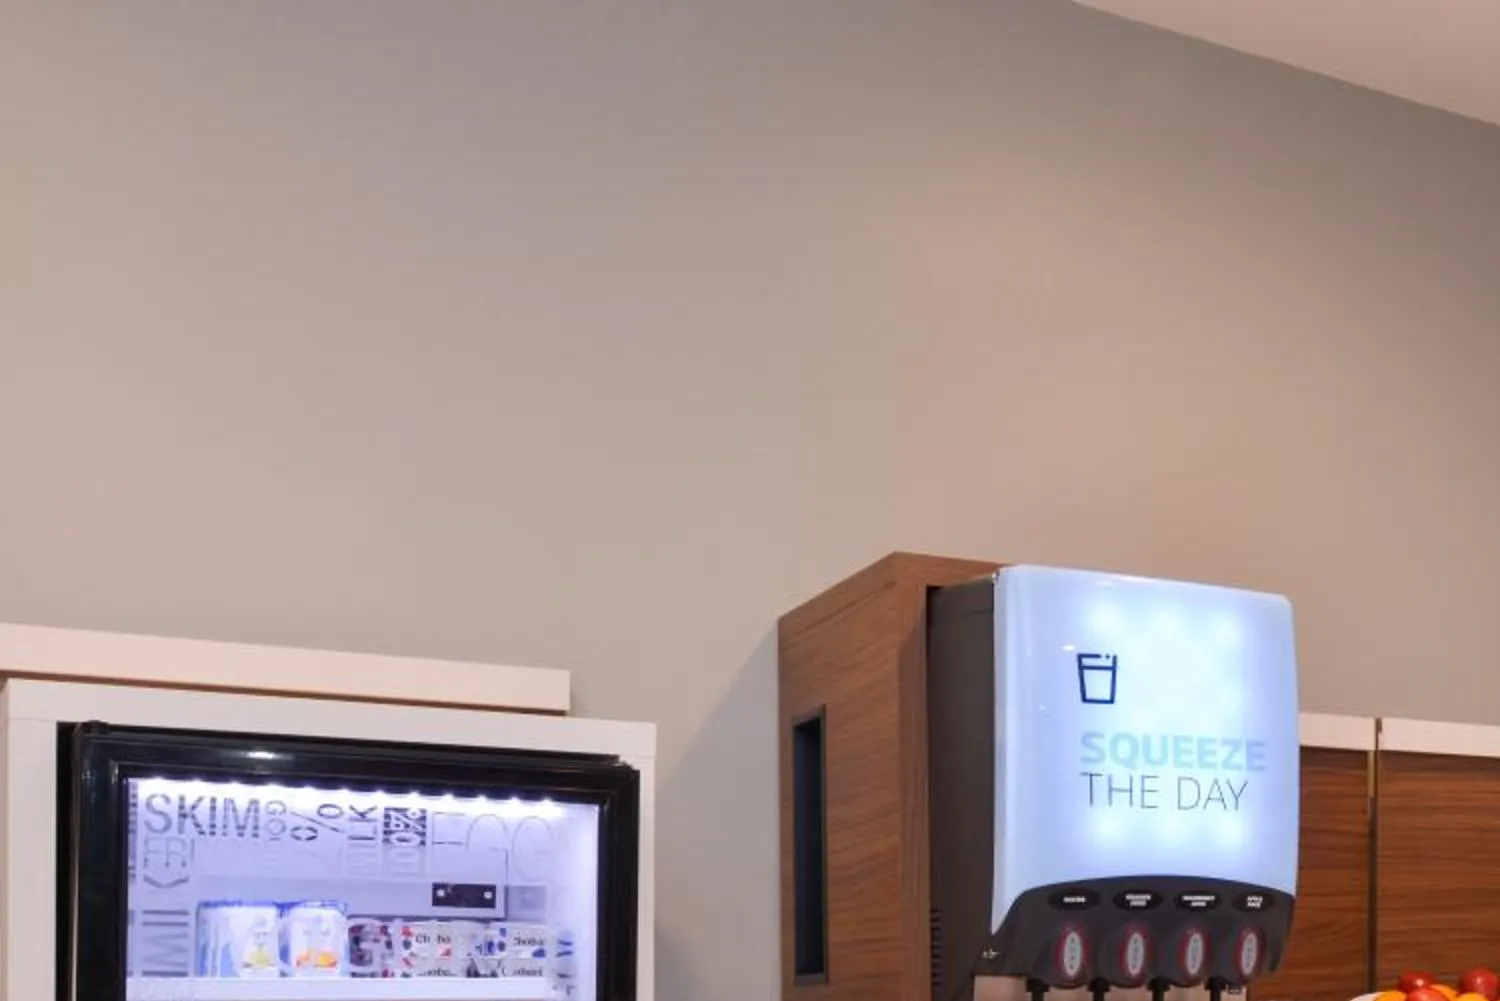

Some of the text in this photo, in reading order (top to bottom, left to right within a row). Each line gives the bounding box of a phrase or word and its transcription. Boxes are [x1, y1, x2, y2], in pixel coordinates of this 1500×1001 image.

[1080, 731, 1268, 773] SQUEEZE
[1079, 771, 1250, 812] THE DAY
[143, 793, 261, 838] SKIM
